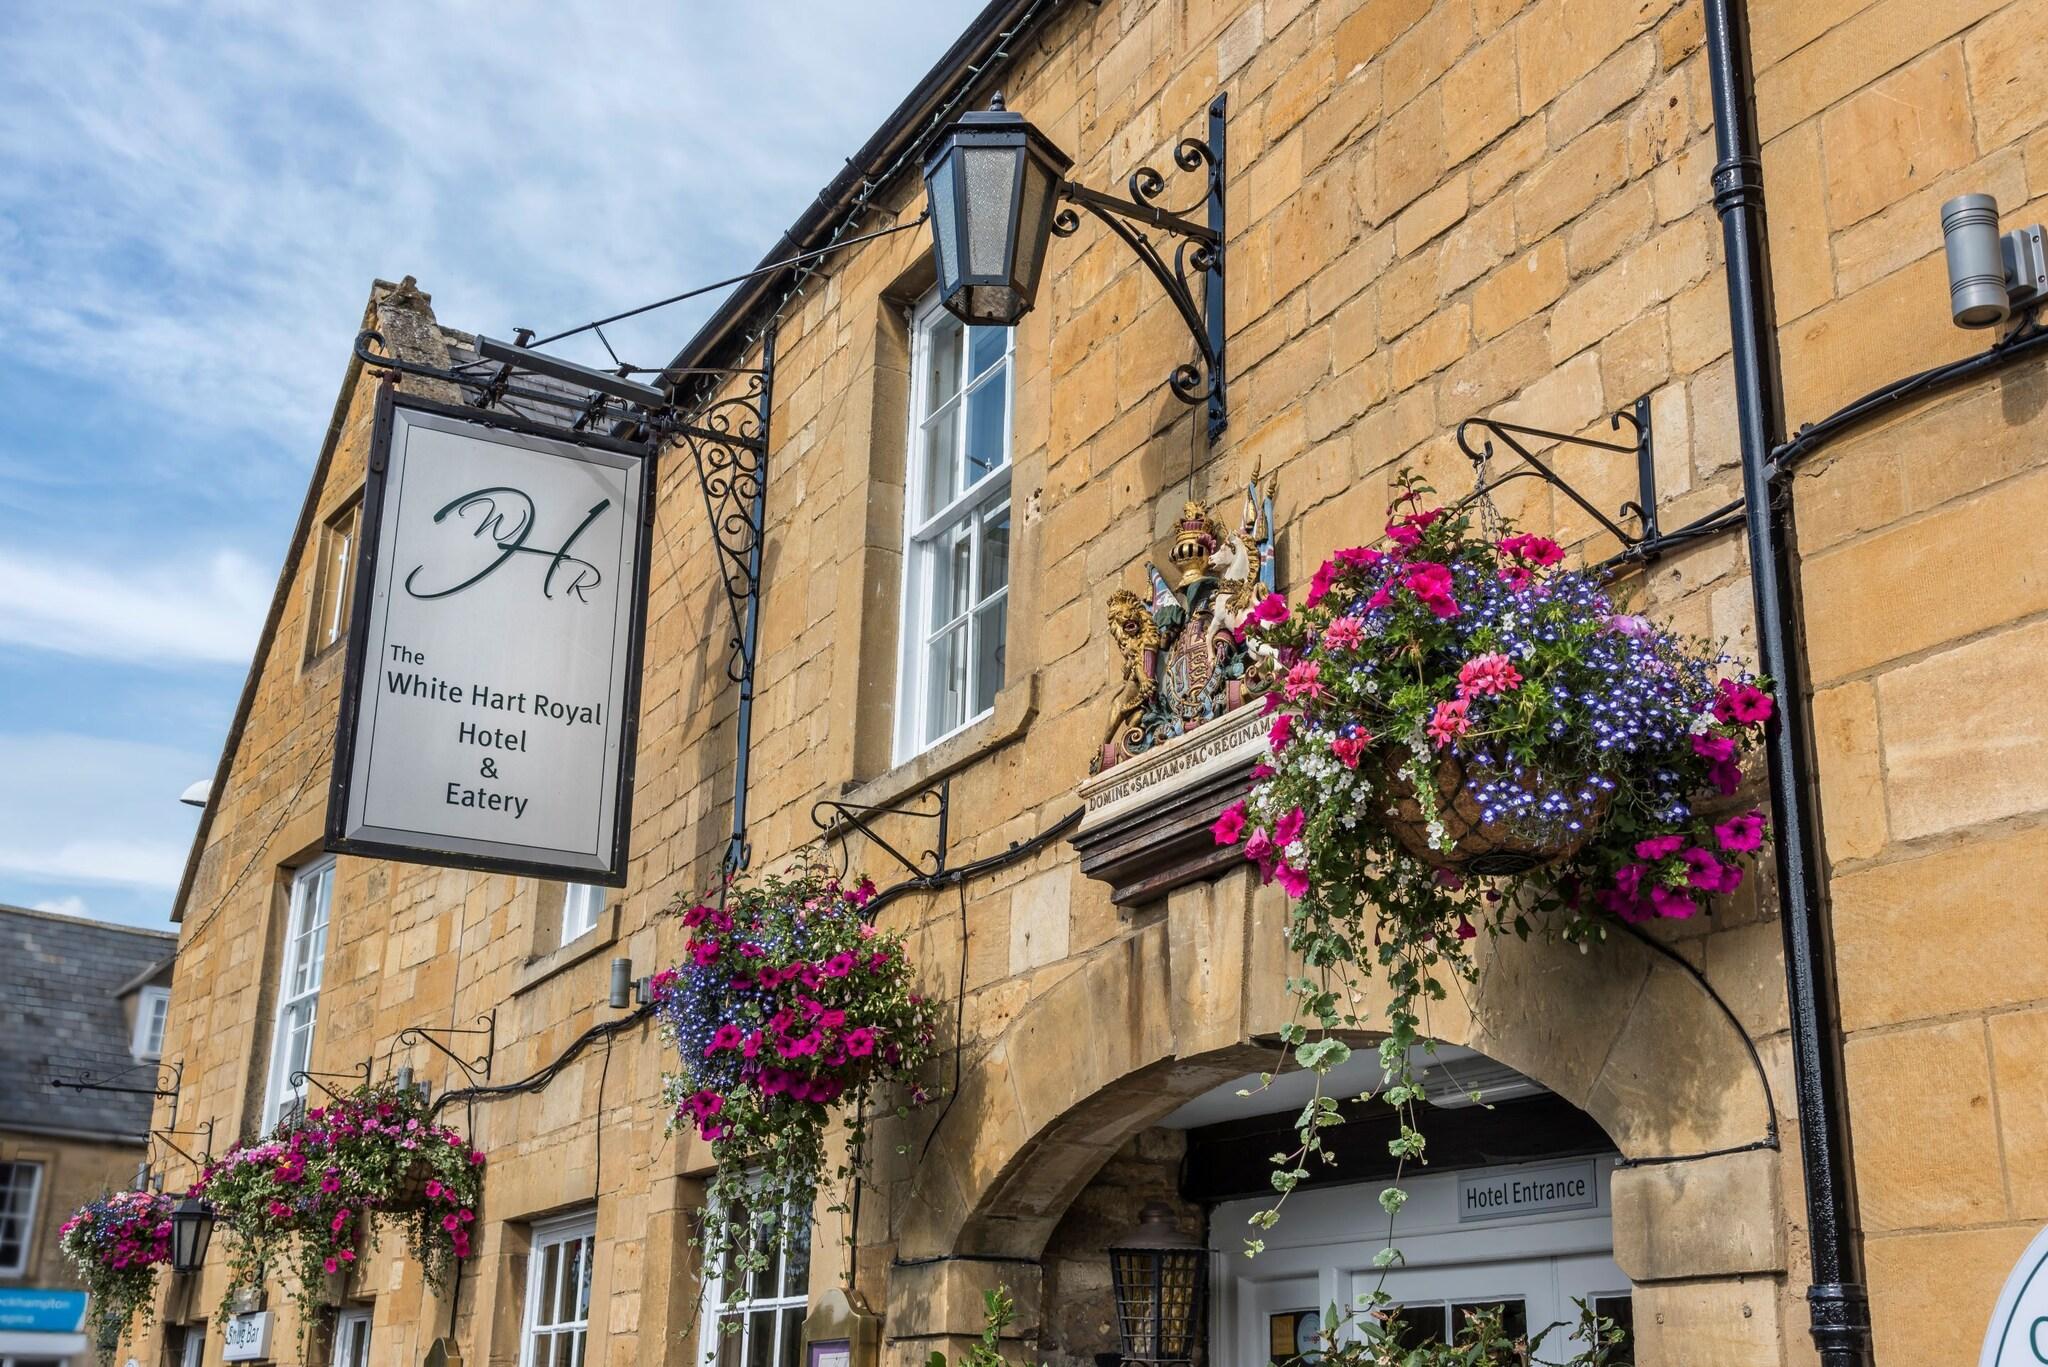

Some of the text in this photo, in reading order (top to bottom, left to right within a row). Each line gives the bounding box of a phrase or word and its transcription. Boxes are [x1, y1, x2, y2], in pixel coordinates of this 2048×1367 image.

[390, 644, 425, 665] The
[387, 671, 601, 726] White Hart Royal
[458, 722, 527, 752] Hotel
[480, 757, 499, 779] &
[1089, 784, 1130, 812] DOMINE
[1135, 760, 1180, 792] SALVAM
[1186, 747, 1208, 770] FAC
[446, 782, 528, 819] Eatery
[1467, 1179, 1585, 1209] Hotel Entrance
[246, 1321, 260, 1343] Bar
